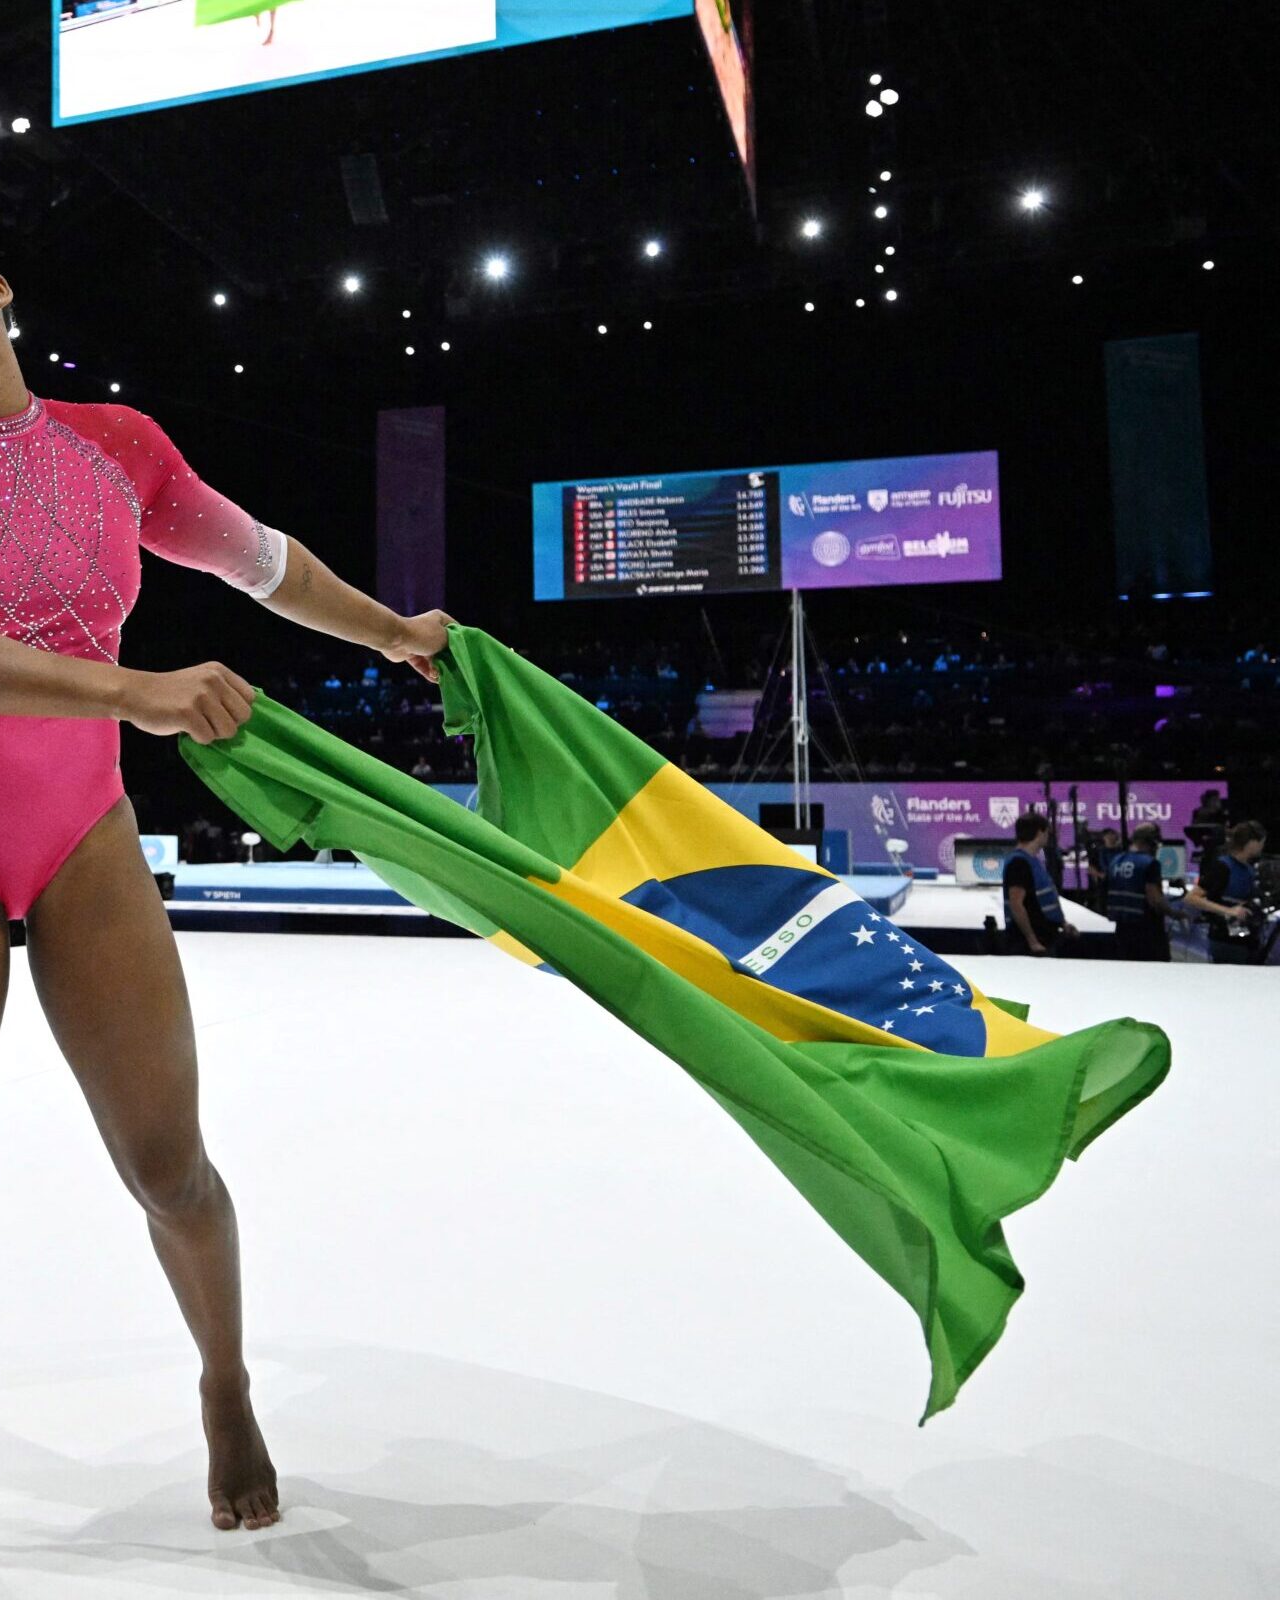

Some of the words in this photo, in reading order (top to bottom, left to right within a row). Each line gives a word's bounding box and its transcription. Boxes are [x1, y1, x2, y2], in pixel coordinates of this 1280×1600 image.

[640, 480, 662, 490] Final
[812, 493, 855, 504] Flanders
[938, 485, 992, 508] FUJITSU
[907, 797, 971, 811] Flanders
[1097, 794, 1171, 820] FUITSU
[908, 812, 931, 823] State
[933, 812, 944, 823] of
[946, 812, 962, 823] the
[744, 914, 812, 972] ESSO
